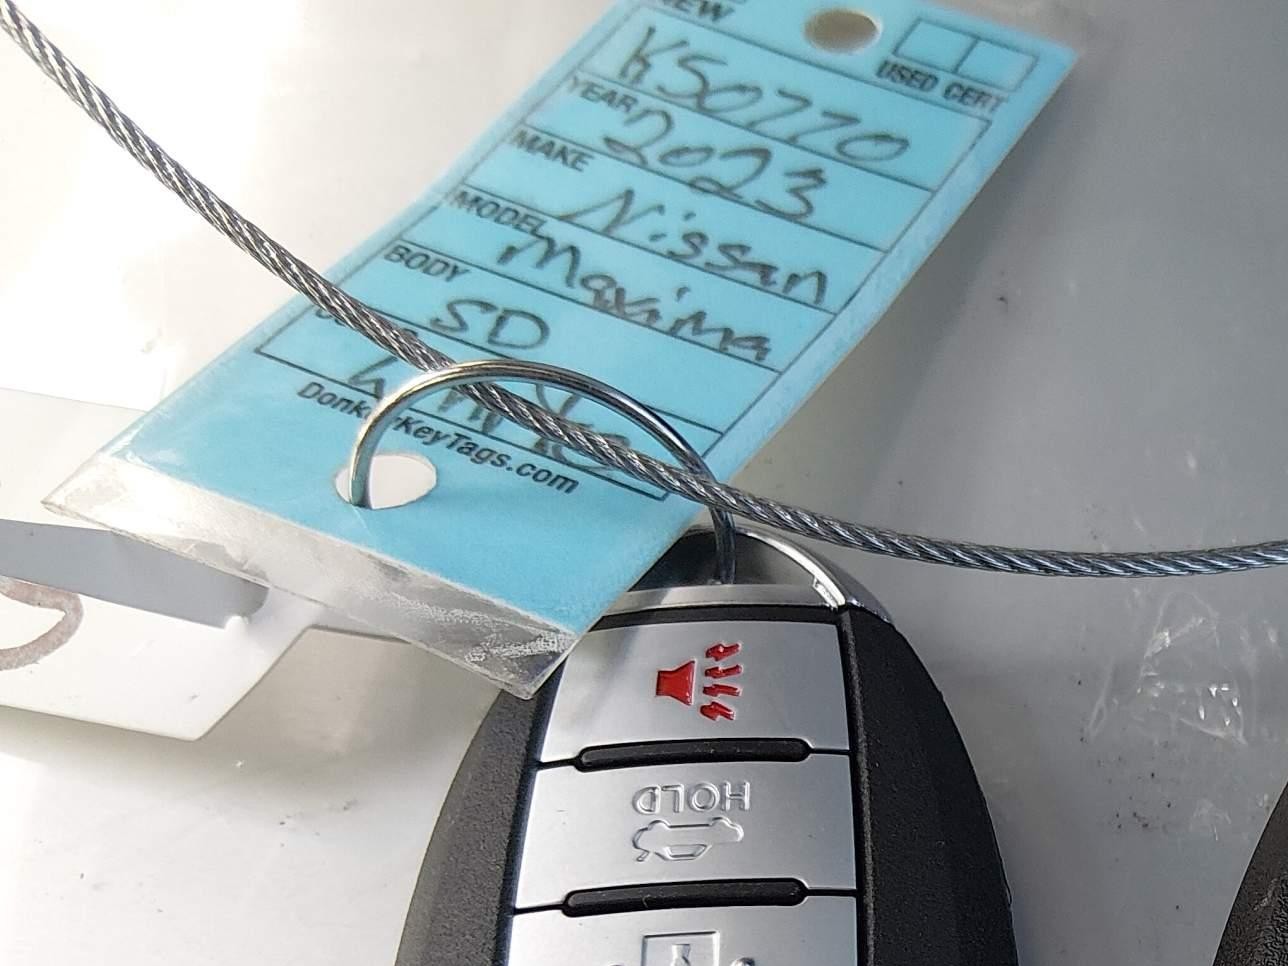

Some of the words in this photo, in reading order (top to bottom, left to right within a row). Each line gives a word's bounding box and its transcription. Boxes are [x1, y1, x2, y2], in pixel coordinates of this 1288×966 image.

[568, 76, 638, 113] YEAR
[876, 59, 939, 92] USED
[512, 129, 595, 172] MAKE
[602, 108, 828, 220] 2023
[455, 190, 548, 237] MODEL
[385, 243, 471, 283] BODY
[430, 299, 551, 350] SD
[631, 780, 751, 815] HOLD
